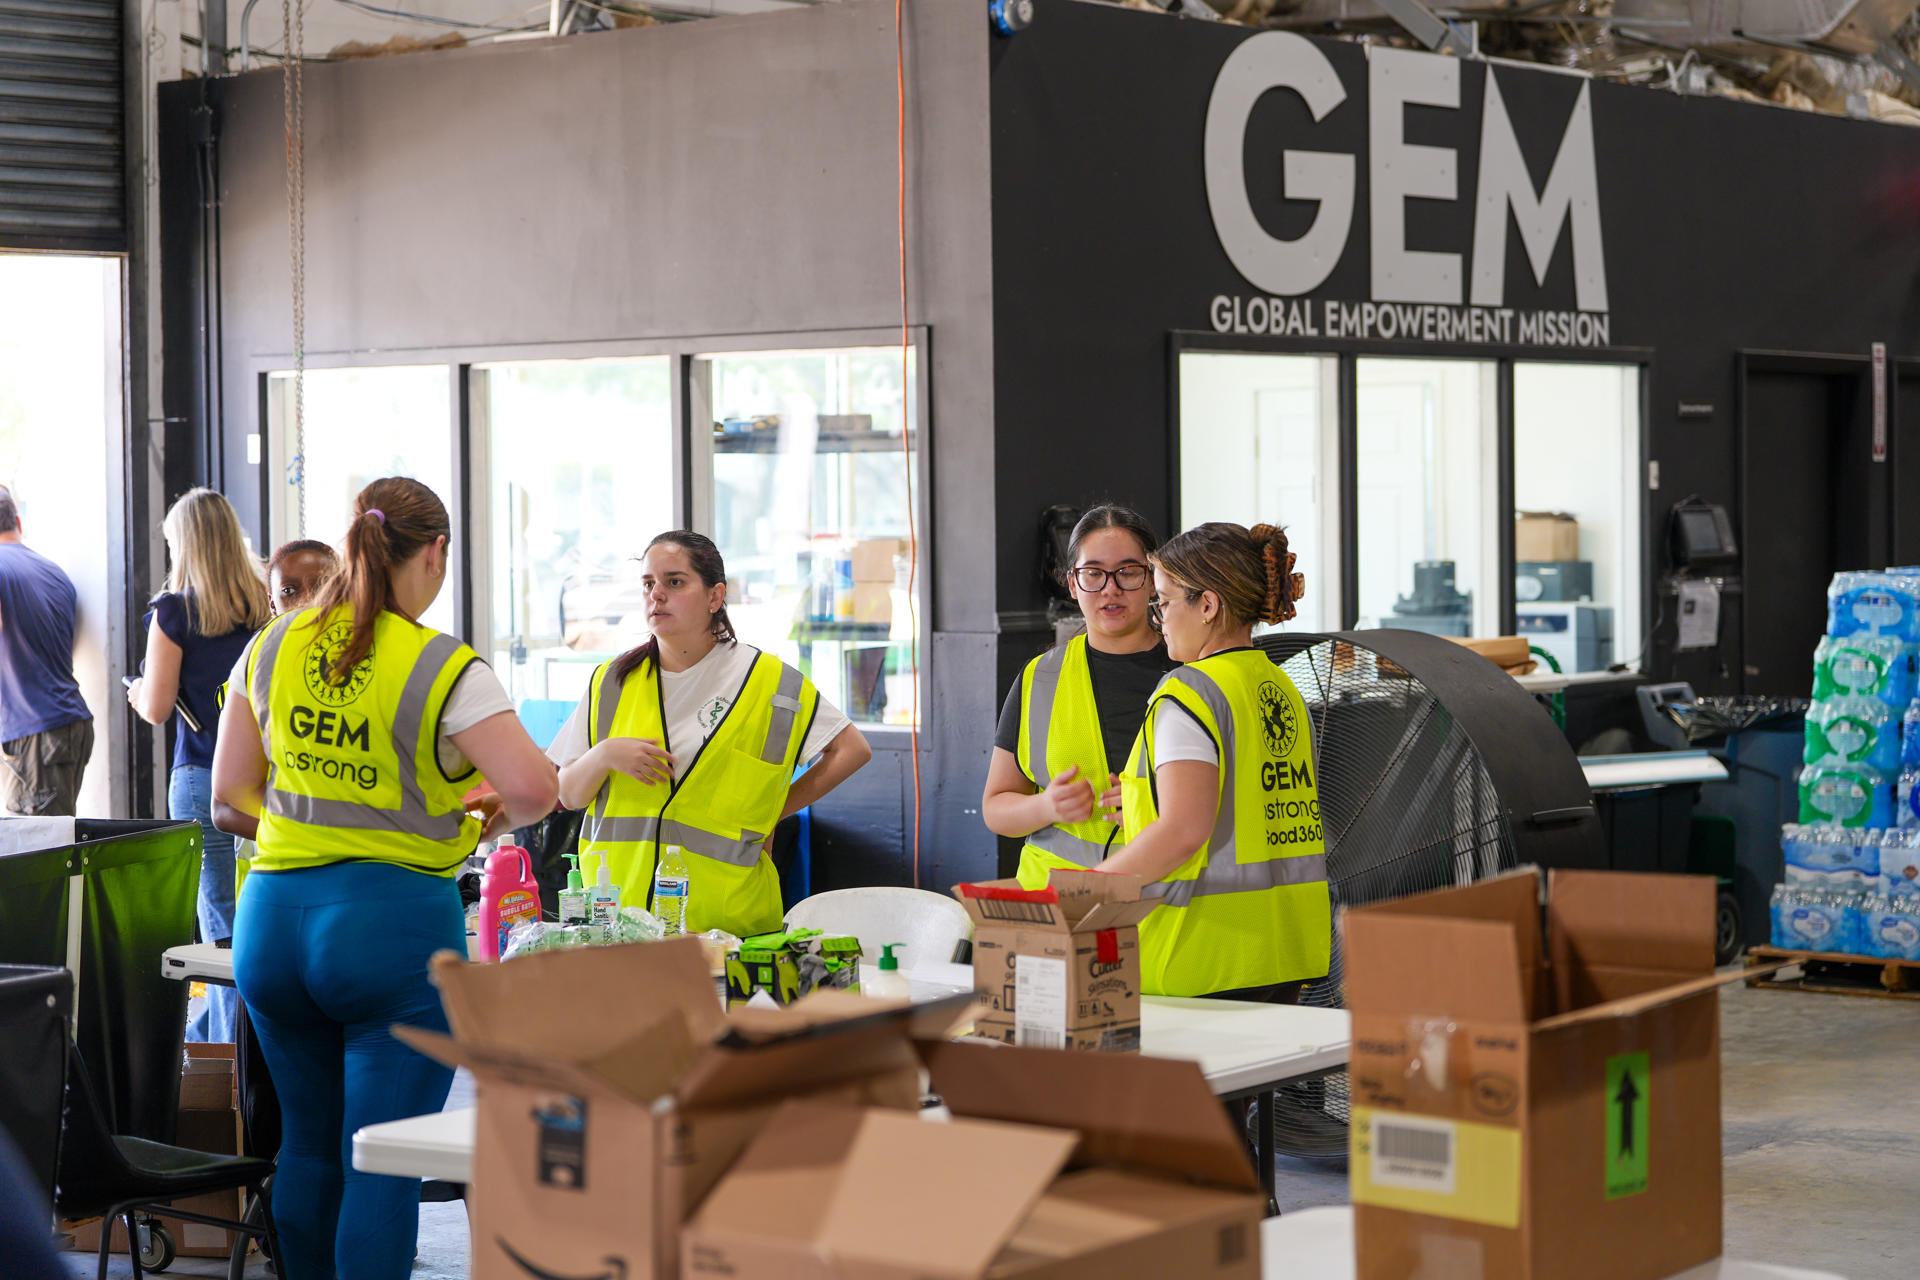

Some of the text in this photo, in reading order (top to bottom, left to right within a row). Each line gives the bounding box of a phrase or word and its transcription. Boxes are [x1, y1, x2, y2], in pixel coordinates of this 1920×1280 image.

[1204, 31, 1609, 312] GEM
[1211, 295, 1610, 347] GLOBAL EMPOWERMENT MISSION
[290, 705, 370, 752] GEM
[1261, 760, 1313, 792] GEM
